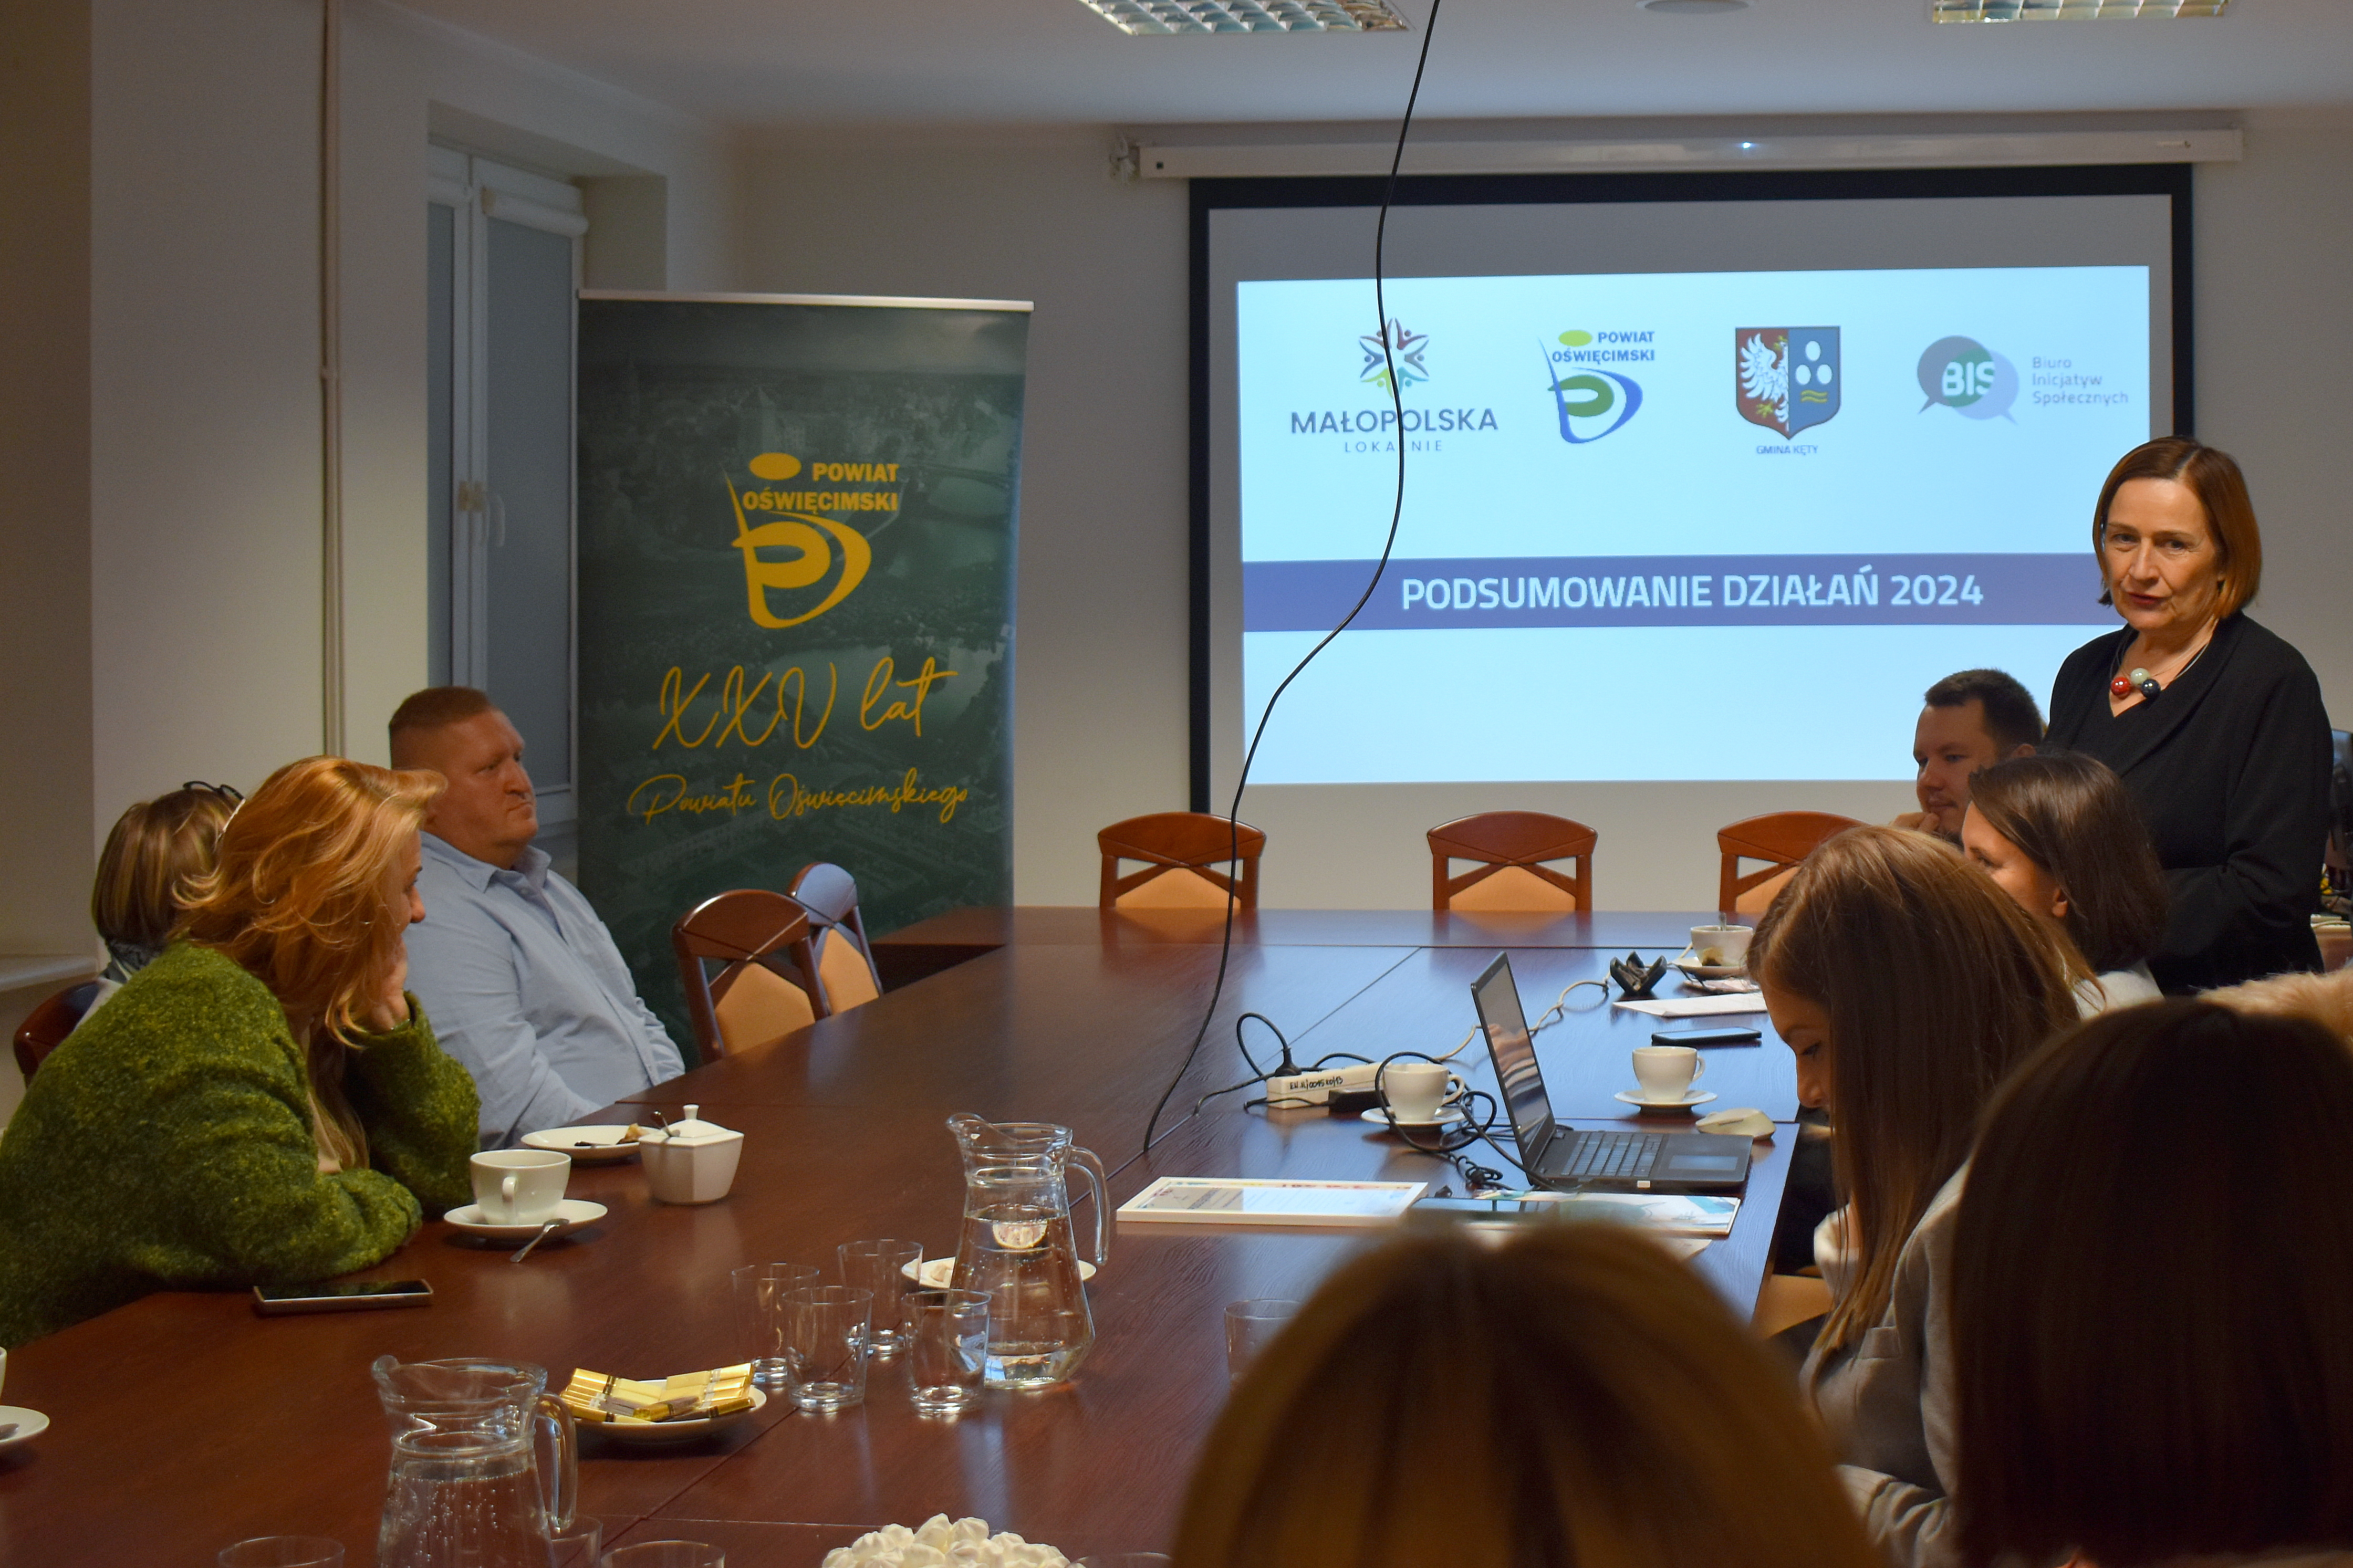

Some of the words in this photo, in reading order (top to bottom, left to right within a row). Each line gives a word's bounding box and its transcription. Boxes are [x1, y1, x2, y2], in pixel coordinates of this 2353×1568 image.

[1598, 331, 1655, 343] POWIAT
[1552, 347, 1655, 365] OŚWIĘCIMSKI
[2032, 356, 2072, 368] Biuro
[1943, 361, 1995, 396] BIS
[2032, 373, 2102, 388] Inicjatyw
[2032, 390, 2129, 407] Społecznych
[1290, 407, 1500, 434] MAŁOPOLSKA
[1345, 440, 1443, 453] LOKANIE
[1756, 445, 1790, 454] GMINA
[1793, 445, 1818, 456] KĘTY
[812, 463, 900, 482] POWIAT
[742, 486, 898, 516] OŚWIĘCIMSKI
[1402, 575, 1713, 610] PODSUMOWANIE
[1723, 564, 1879, 607] DZIAŁAŃ
[1890, 574, 1984, 605] 2024
[652, 662, 837, 749] XXV
[859, 656, 959, 738] lat
[627, 772, 757, 825] Powiatu
